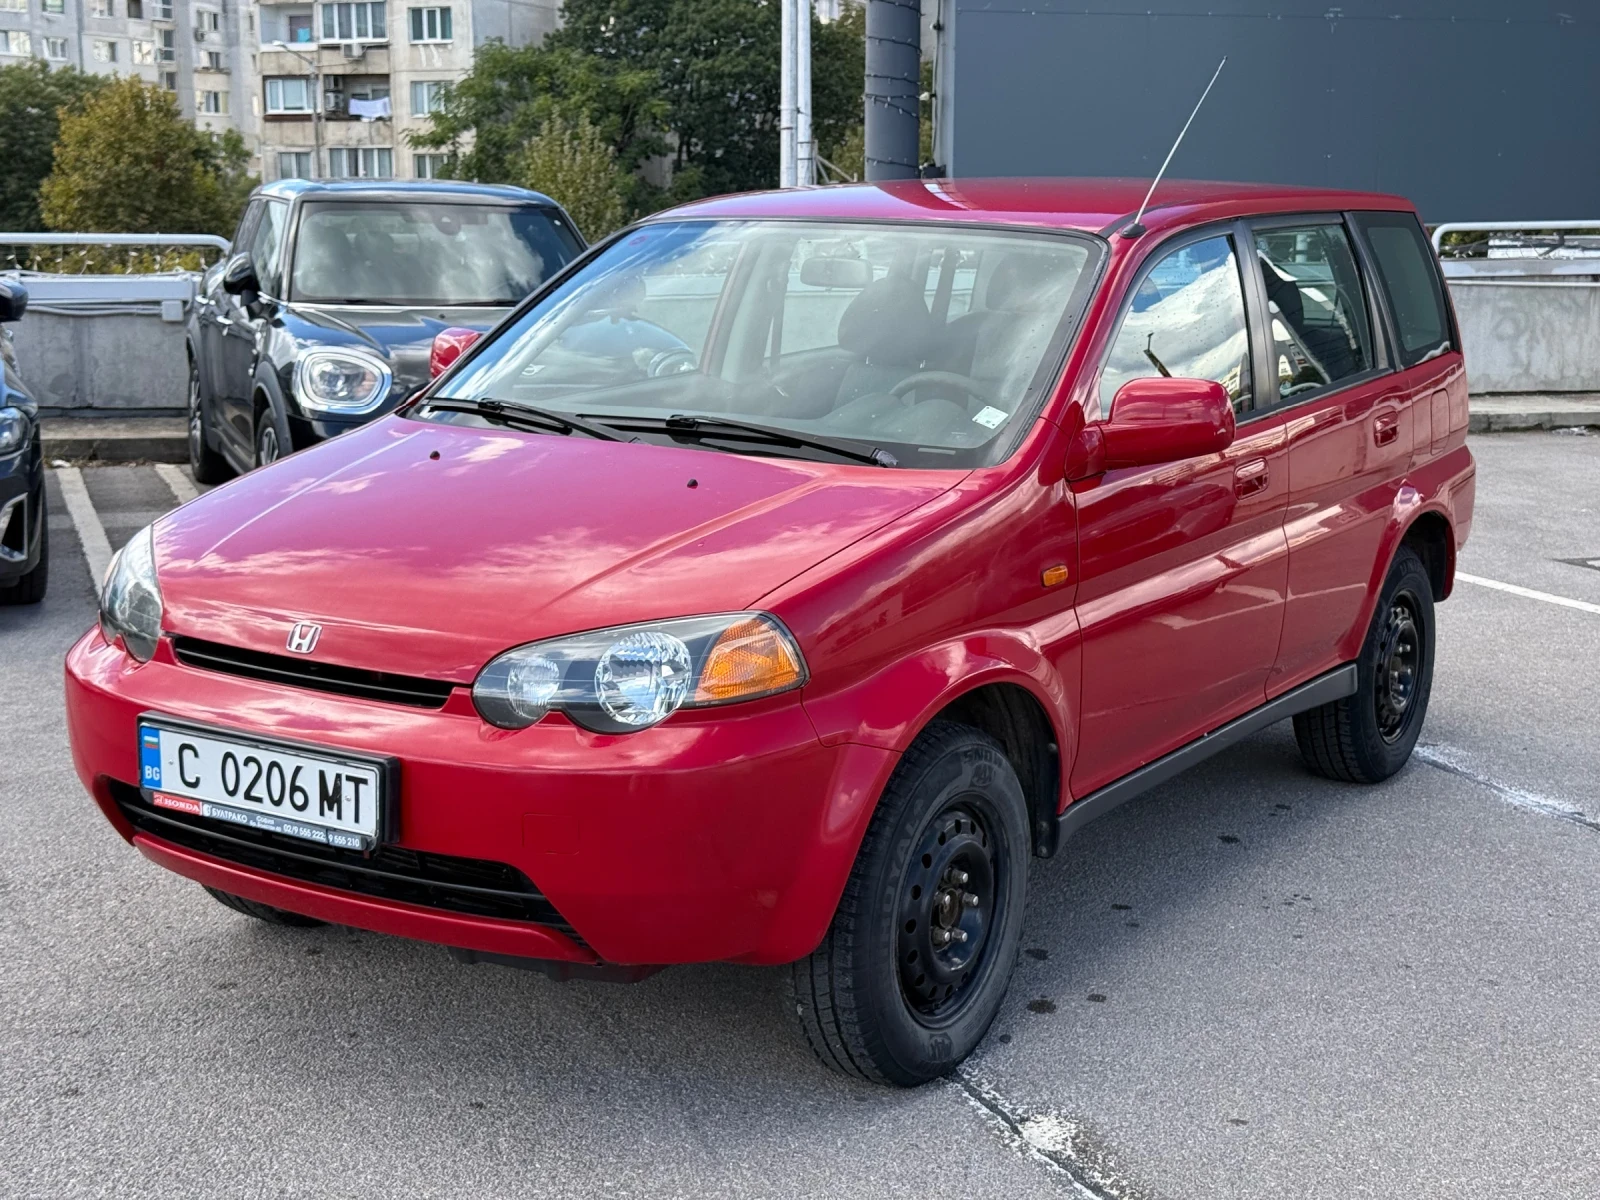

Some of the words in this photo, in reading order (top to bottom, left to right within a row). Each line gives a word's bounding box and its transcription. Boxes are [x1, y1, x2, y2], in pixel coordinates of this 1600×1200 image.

[145, 765, 160, 780] BG
[178, 743, 200, 788] C
[221, 751, 309, 812] 0206
[319, 769, 368, 824] MT
[165, 798, 200, 812] HONDA
[212, 808, 248, 823] БУЛТРАКО
[283, 823, 299, 835] 02/9
[299, 827, 311, 837] 555
[328, 834, 333, 842] 9
[334, 836, 347, 846] 555
[347, 838, 360, 847] 210
